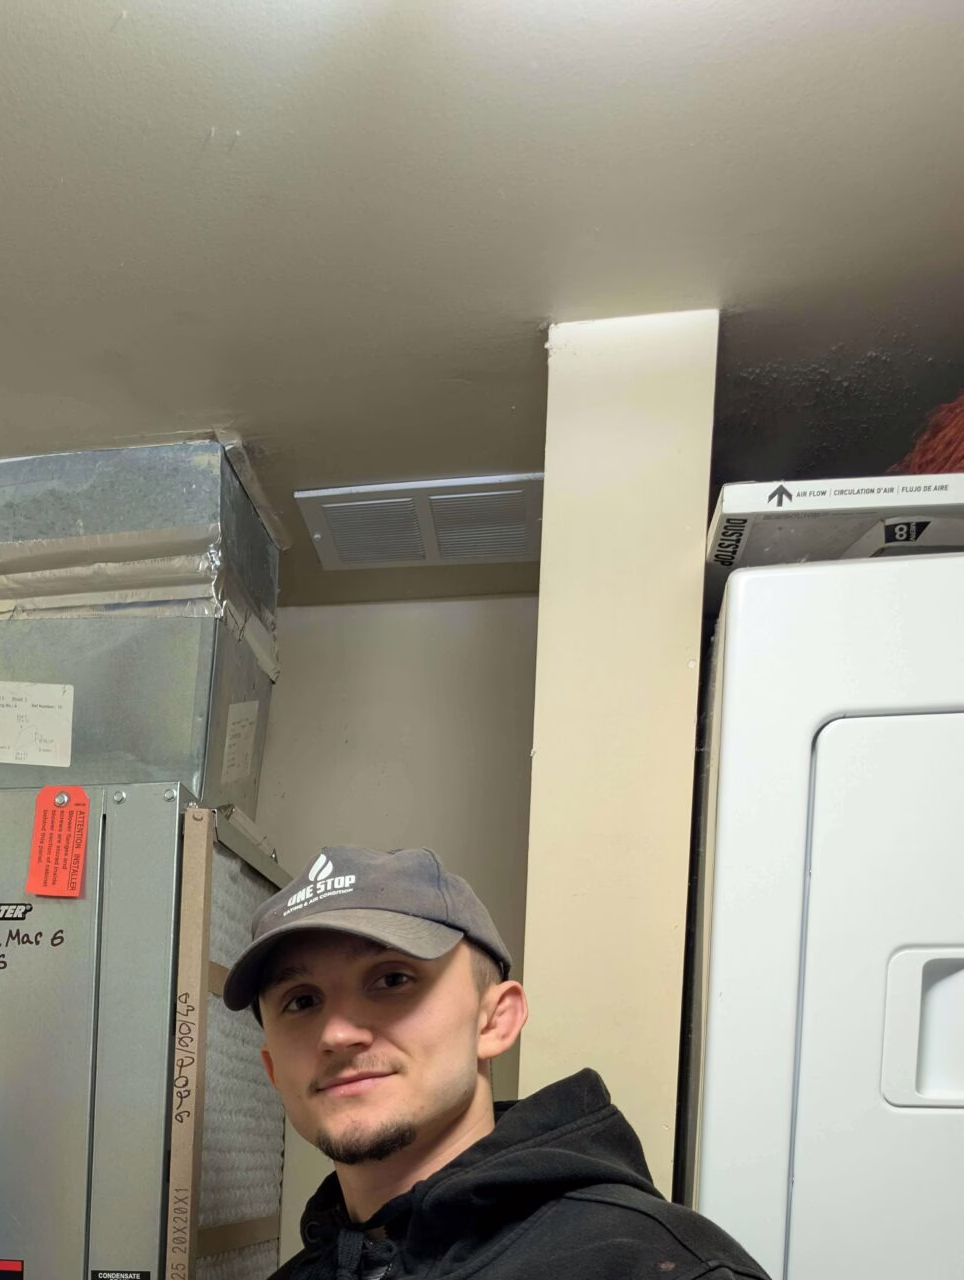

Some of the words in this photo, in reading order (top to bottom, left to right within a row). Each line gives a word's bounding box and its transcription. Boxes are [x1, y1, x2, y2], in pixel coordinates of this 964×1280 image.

[834, 488, 875, 496] CIRCULATION
[932, 484, 949, 492] AIRE
[714, 518, 748, 566] DUSTSTOP
[895, 524, 908, 540] 8
[74, 810, 85, 848] ATTENTION
[69, 854, 80, 890] INSTALLER
[288, 884, 314, 907] ONE
[316, 875, 355, 894] STOP
[51, 929, 64, 946] 6
[171, 1187, 188, 1254] 20X20X1
